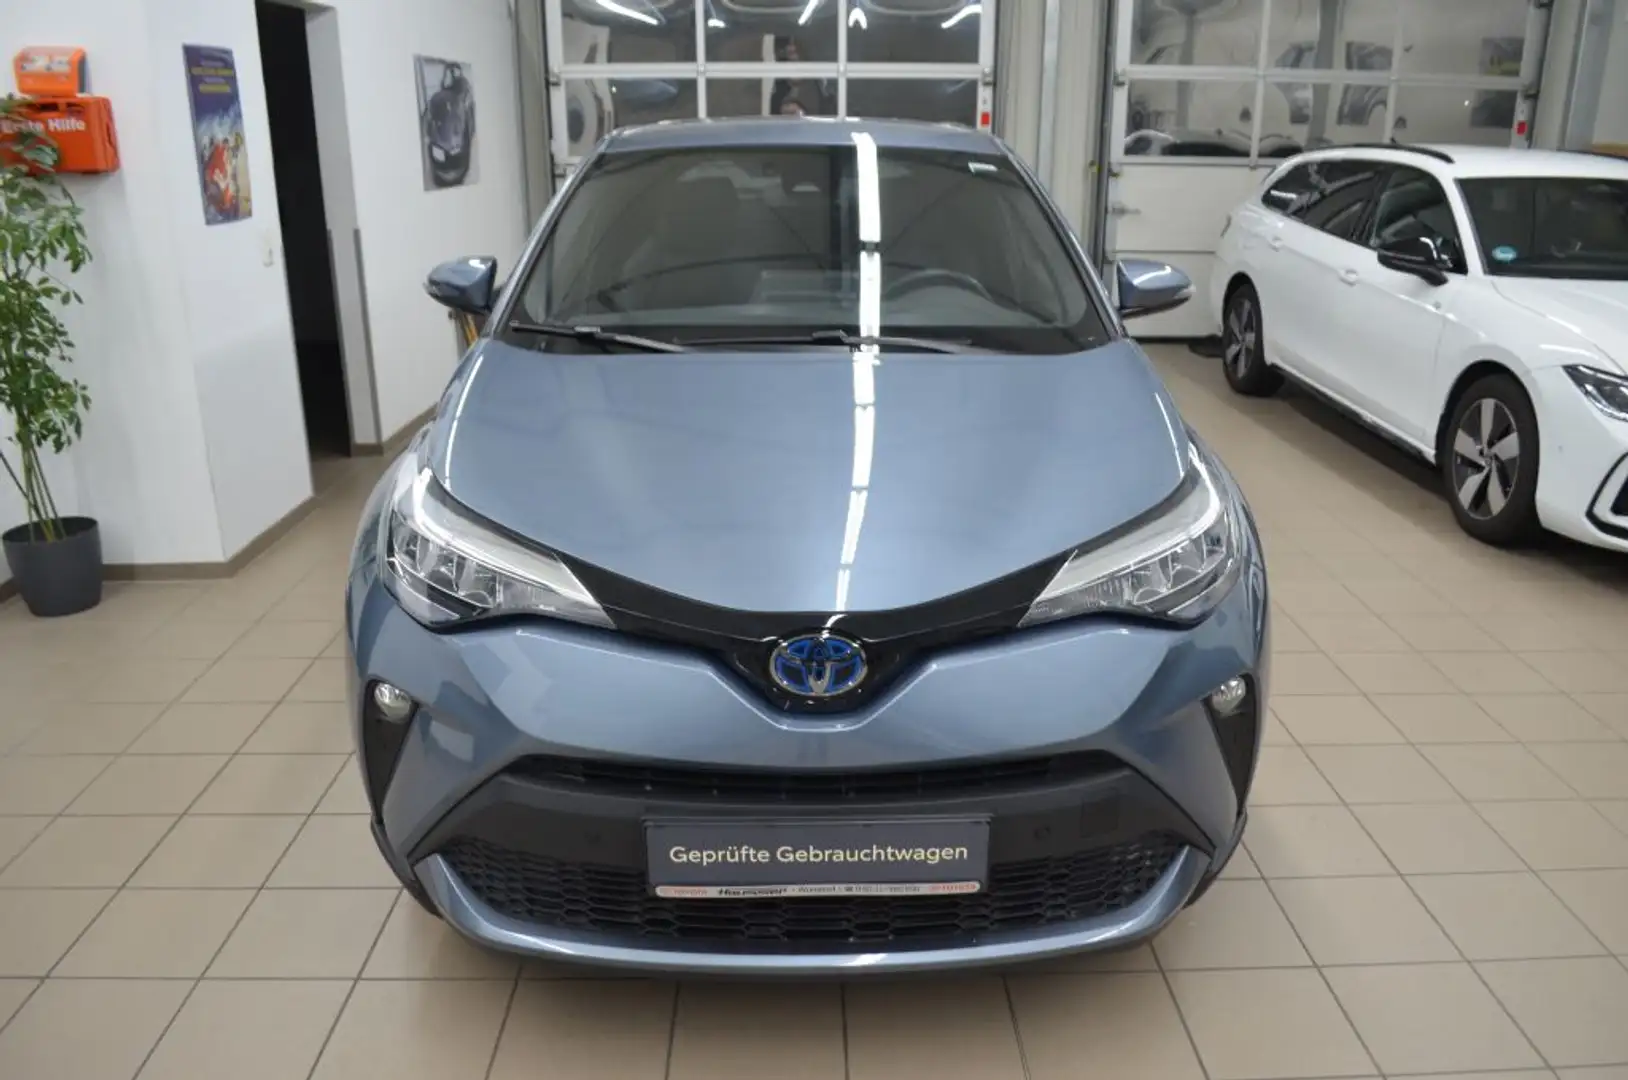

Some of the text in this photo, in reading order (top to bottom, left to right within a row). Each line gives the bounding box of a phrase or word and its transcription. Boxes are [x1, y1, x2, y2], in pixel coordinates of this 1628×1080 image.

[47, 117, 86, 132] Hilfe
[669, 844, 968, 866] Geprüfte Gebrauchtwagen
